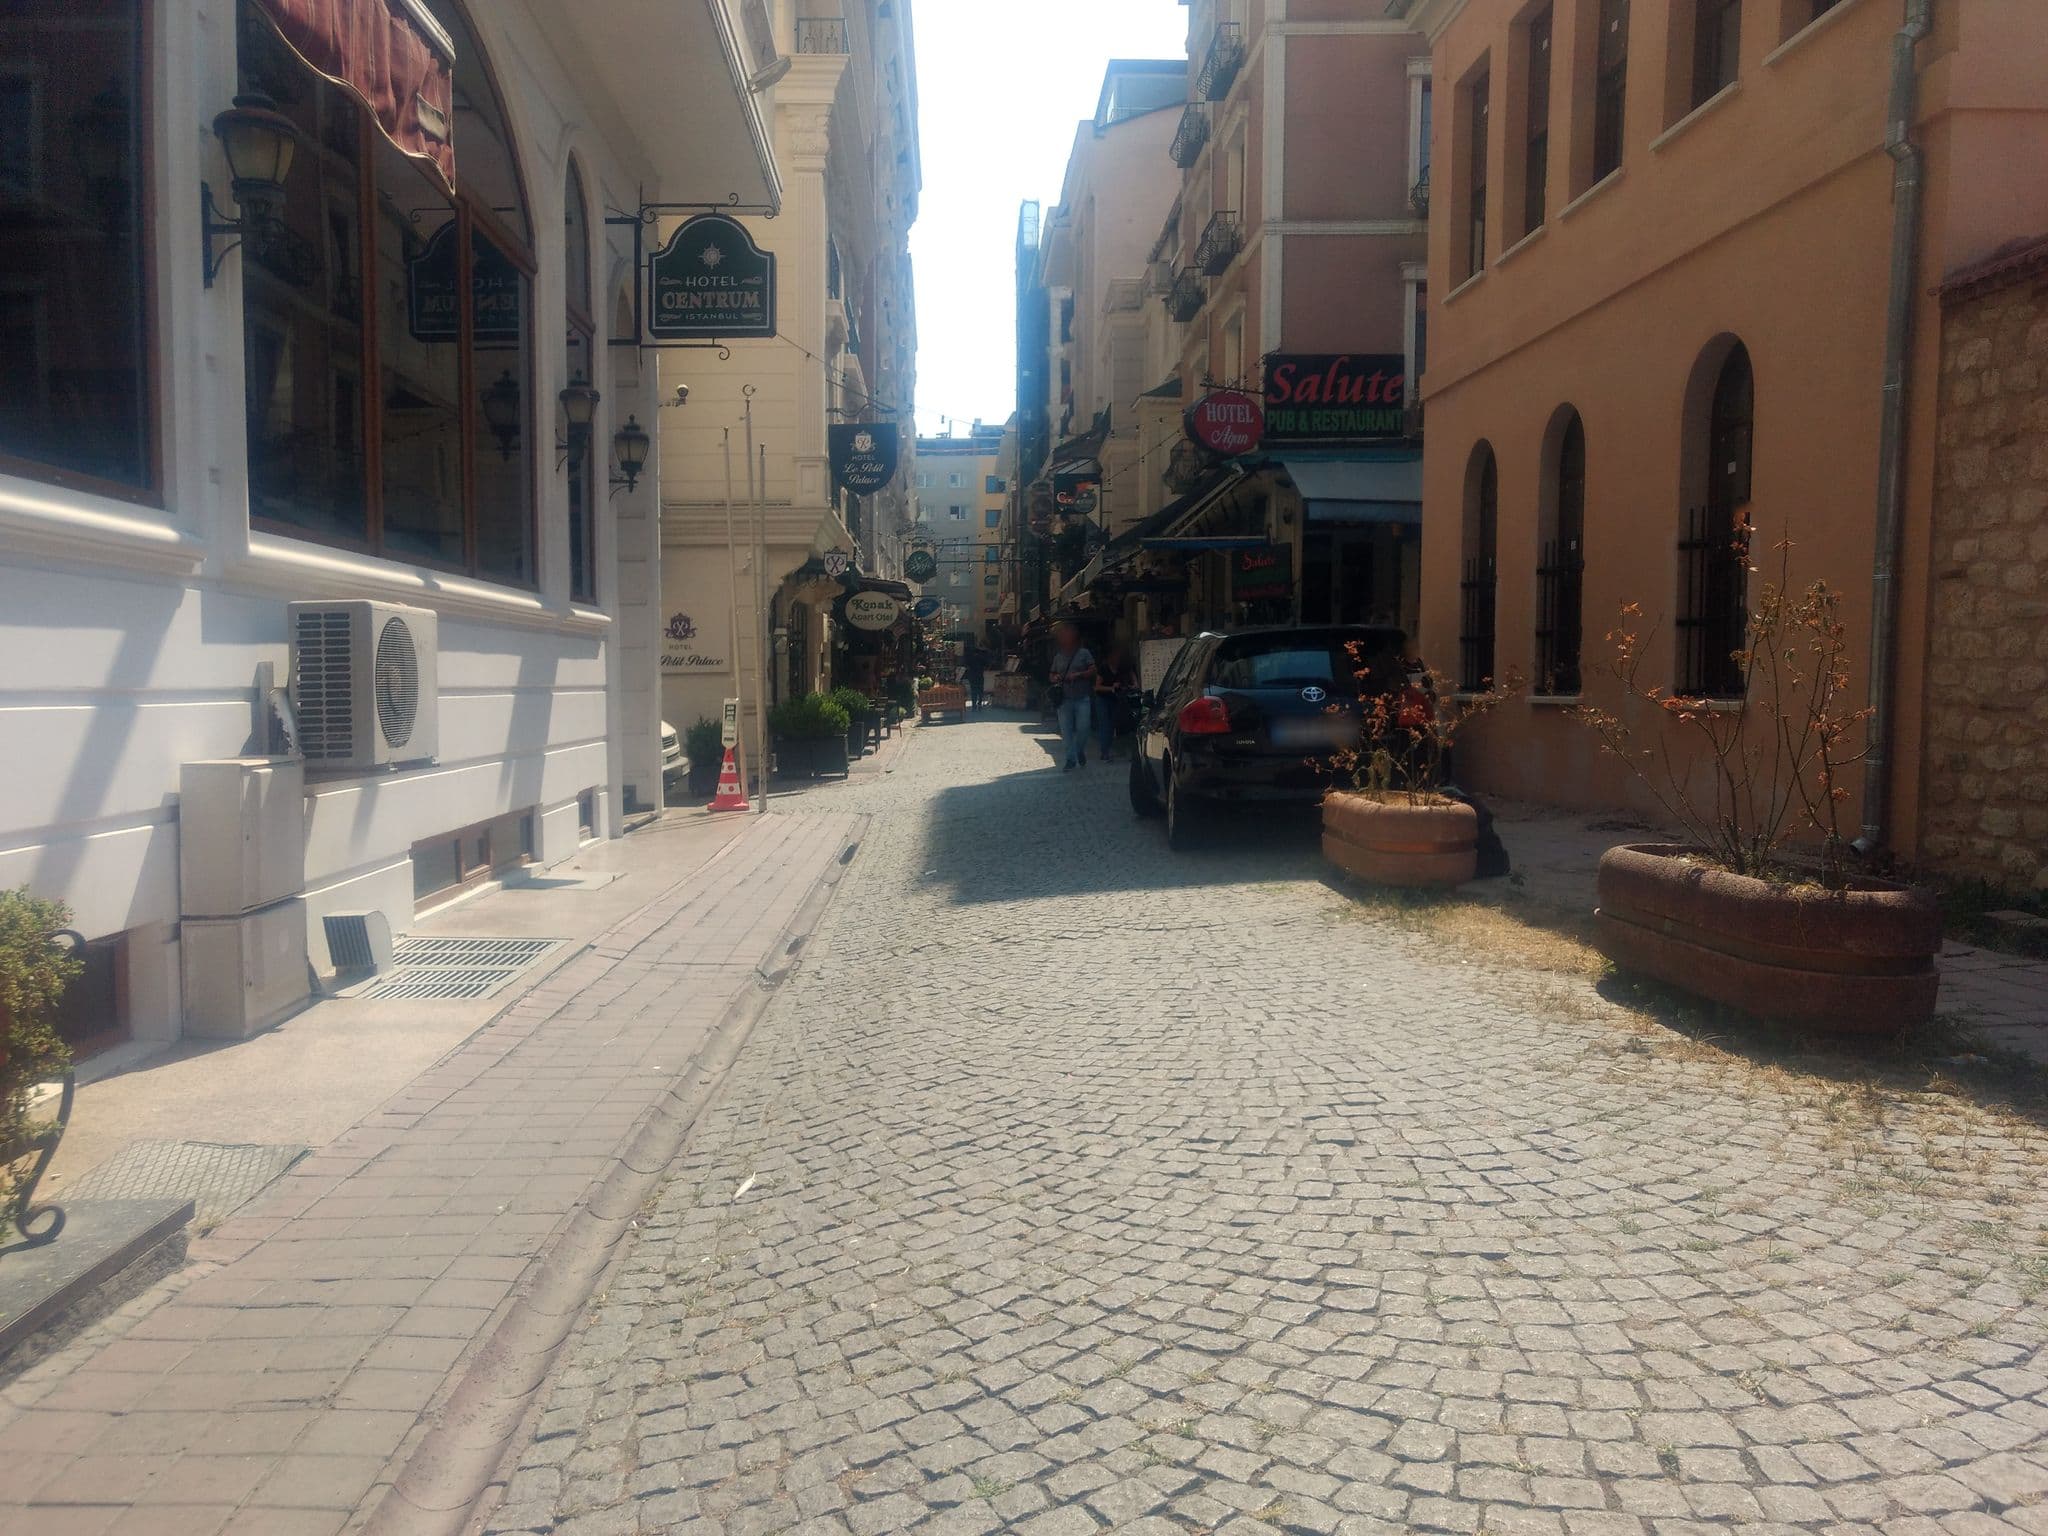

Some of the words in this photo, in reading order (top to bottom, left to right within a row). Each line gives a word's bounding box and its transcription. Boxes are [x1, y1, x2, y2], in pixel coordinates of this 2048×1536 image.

[685, 275, 739, 287] HOTEL
[661, 291, 761, 310] CENTRUM
[1266, 356, 1404, 404] Salute
[1206, 403, 1255, 424] HOTEL
[1266, 408, 1297, 432] PUB
[1298, 409, 1309, 432] &
[1311, 409, 1403, 432] RESTAURANT
[851, 454, 876, 462] HOTEL
[848, 473, 880, 484] Palace
[851, 599, 893, 612] Konak
[686, 655, 724, 667] Palace
